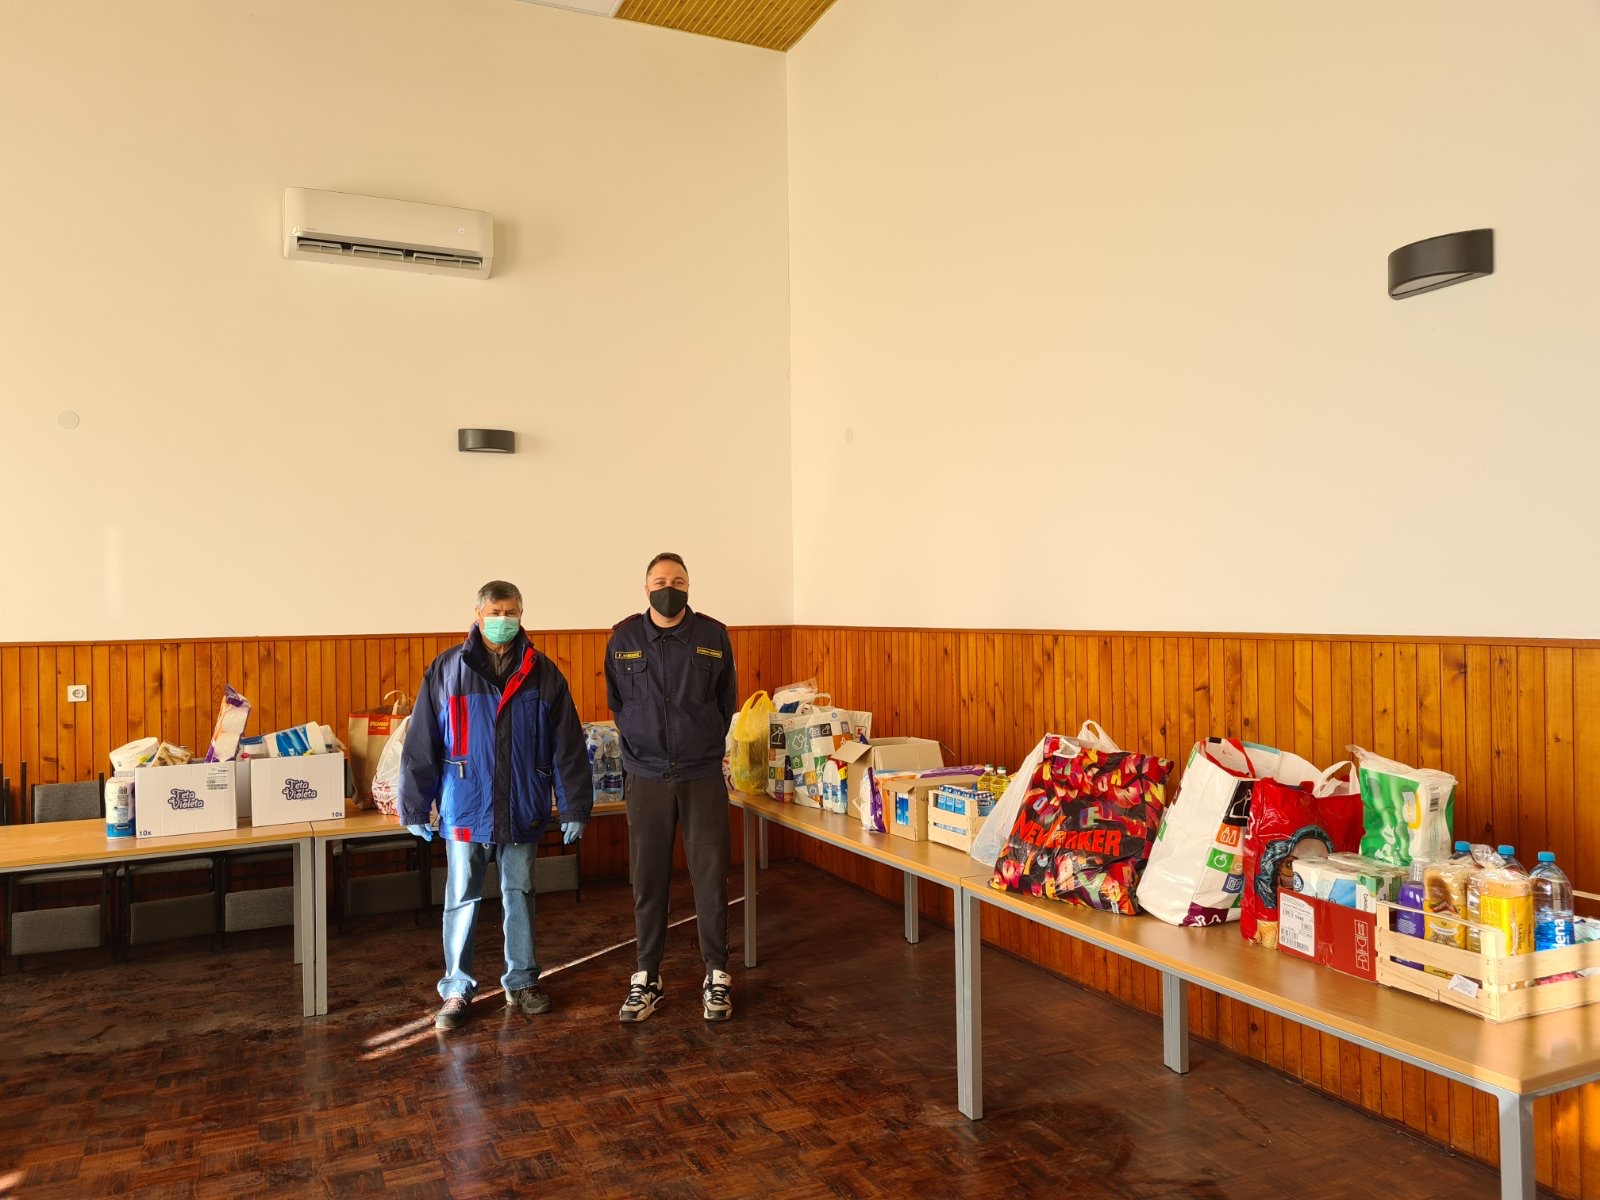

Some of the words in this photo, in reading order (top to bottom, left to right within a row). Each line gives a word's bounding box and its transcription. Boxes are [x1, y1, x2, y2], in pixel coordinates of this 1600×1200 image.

[285, 778, 309, 790] Teta
[171, 788, 195, 799] Teta
[282, 787, 317, 800] Violeta
[168, 797, 204, 810] Violeta
